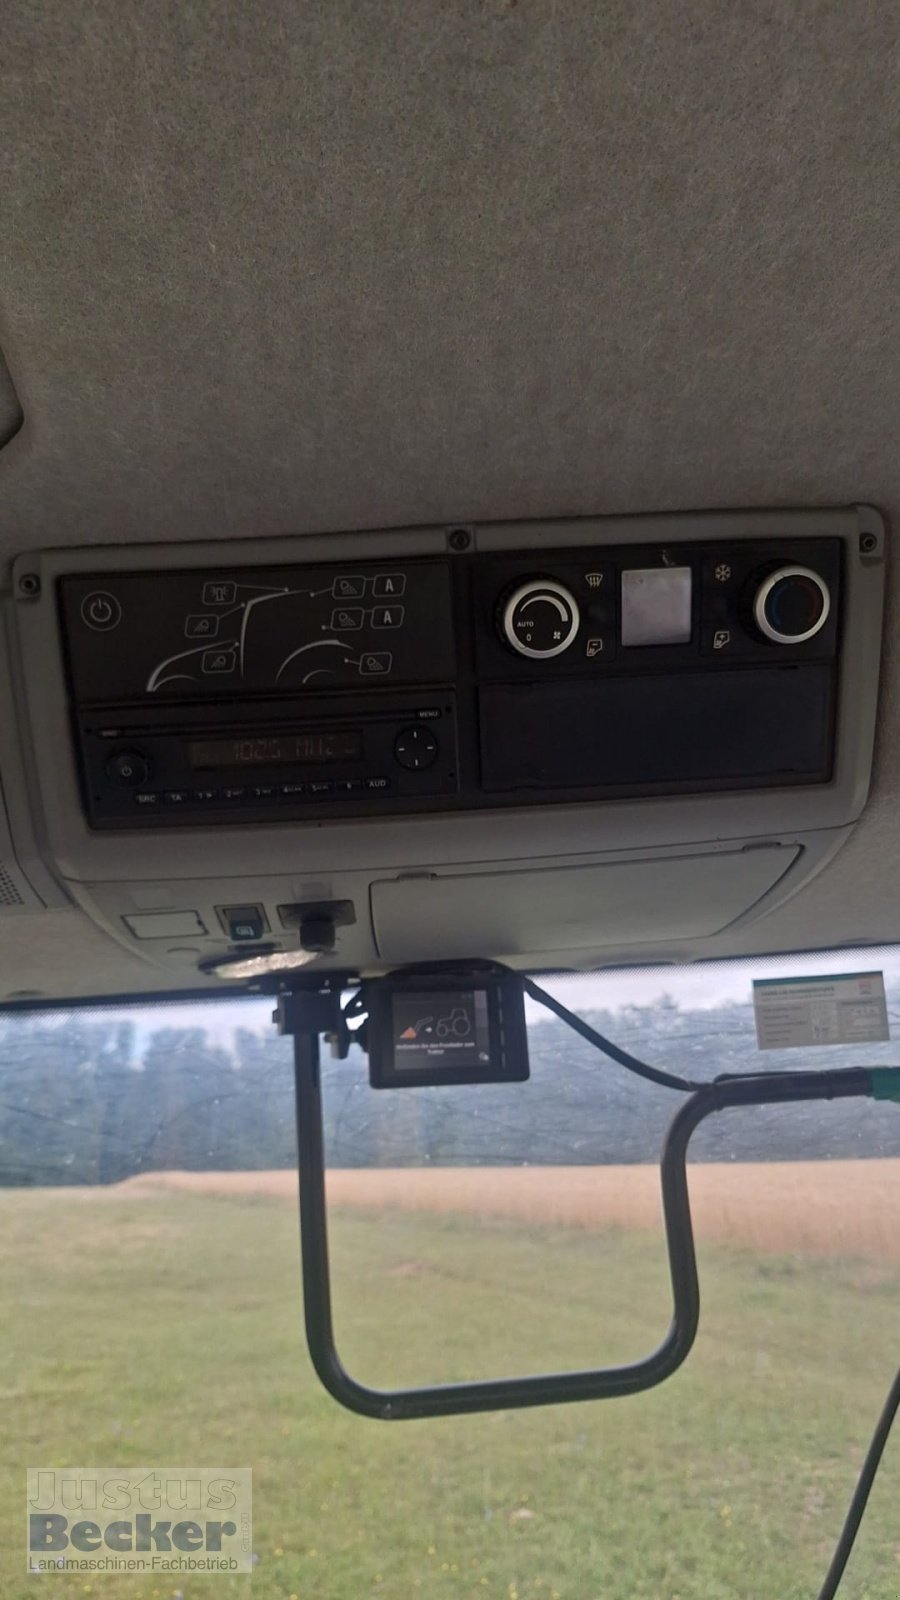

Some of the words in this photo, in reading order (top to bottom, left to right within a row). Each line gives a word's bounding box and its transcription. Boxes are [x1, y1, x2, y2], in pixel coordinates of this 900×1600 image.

[384, 579, 394, 593] A
[382, 610, 392, 624] A
[517, 620, 534, 629] AUTO
